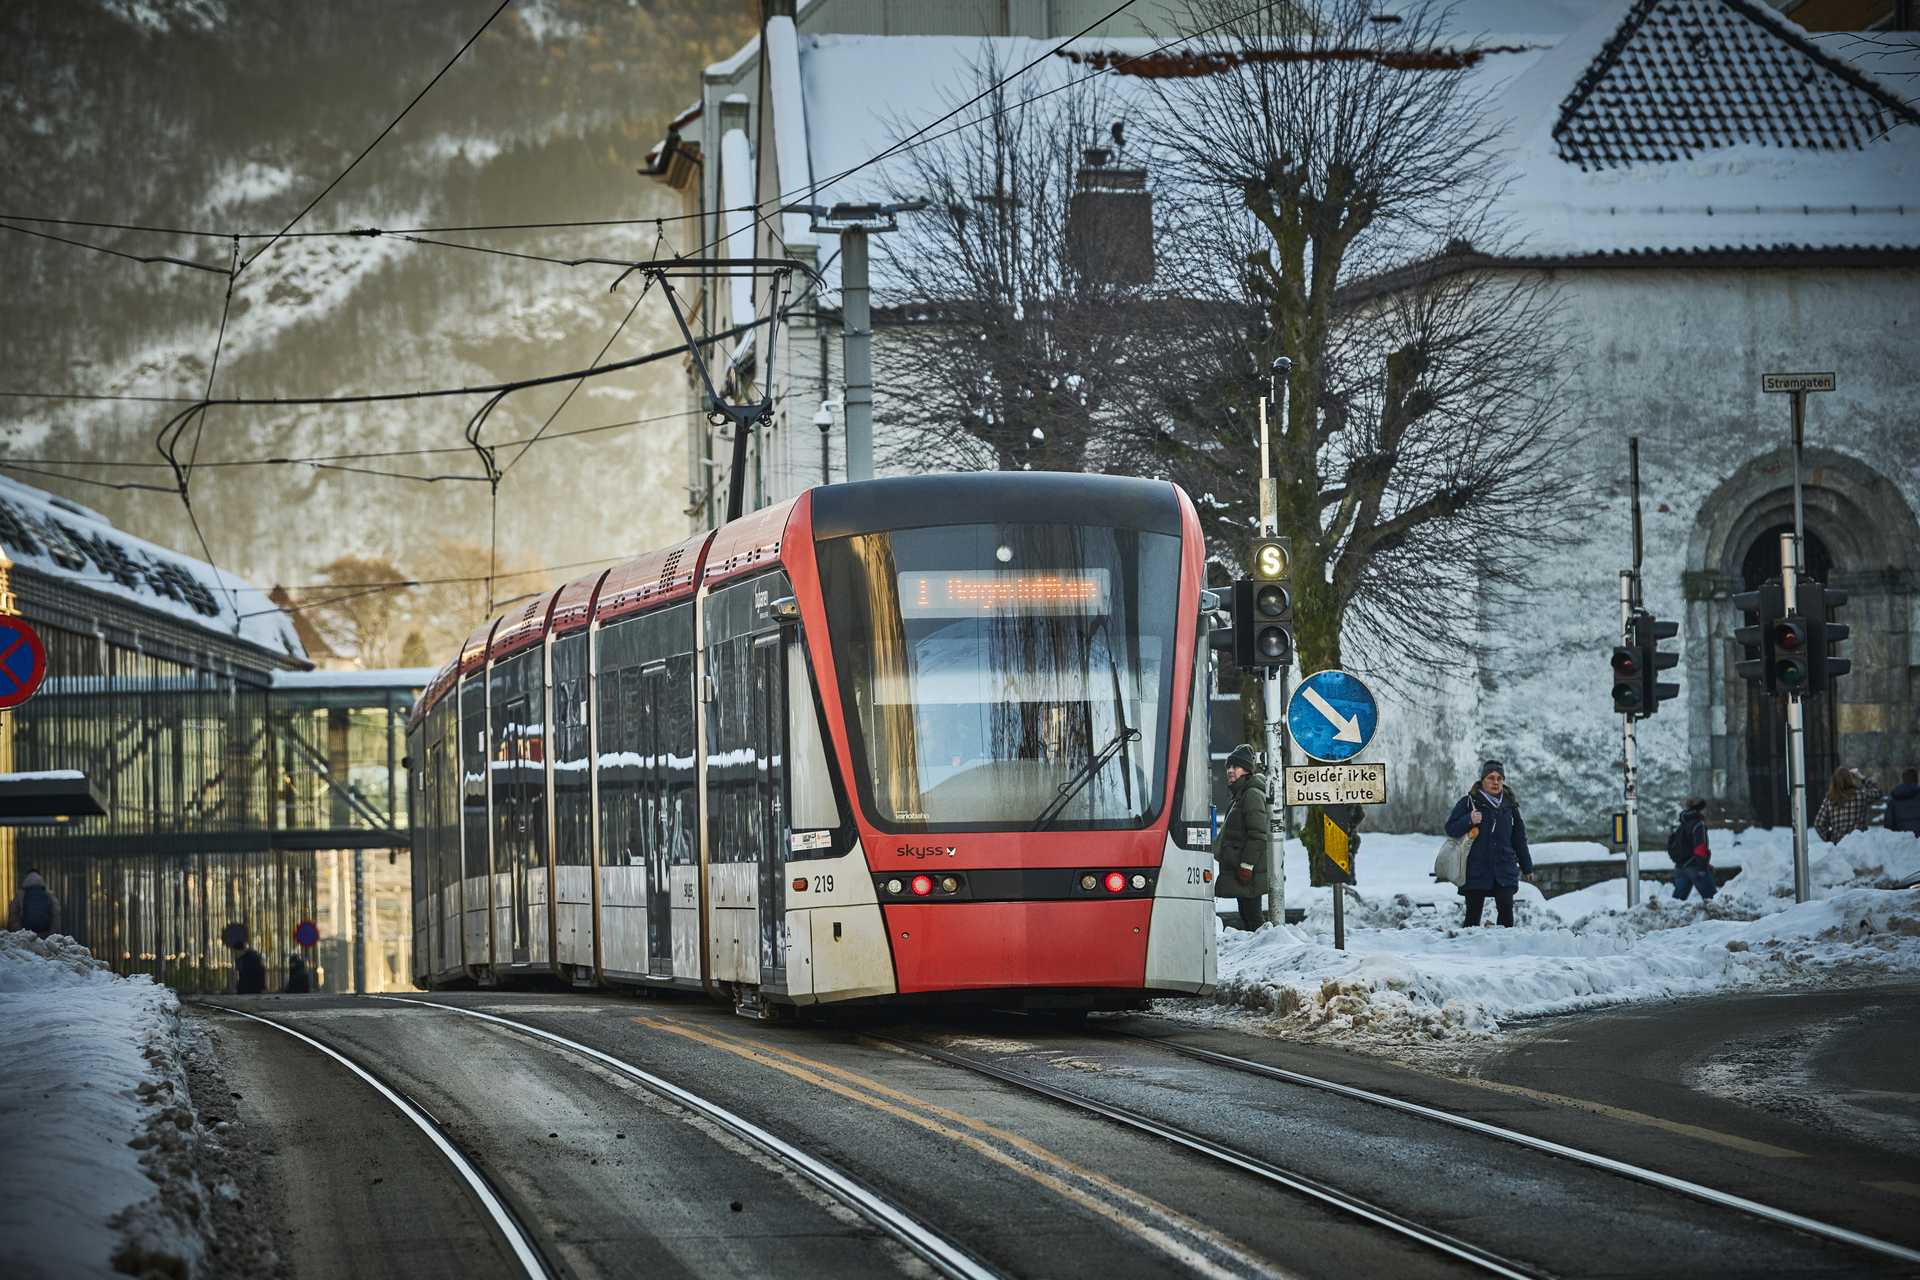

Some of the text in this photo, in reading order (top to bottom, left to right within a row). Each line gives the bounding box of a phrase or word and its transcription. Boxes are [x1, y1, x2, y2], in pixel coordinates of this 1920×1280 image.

[1767, 377, 1831, 390] Strømgaten
[1263, 547, 1280, 575] S
[1293, 769, 1377, 786] Gjelder ikke
[1297, 788, 1374, 801] buss i rute
[896, 844, 944, 859] skyss
[814, 874, 834, 893] 219
[1187, 866, 1201, 885] 219
